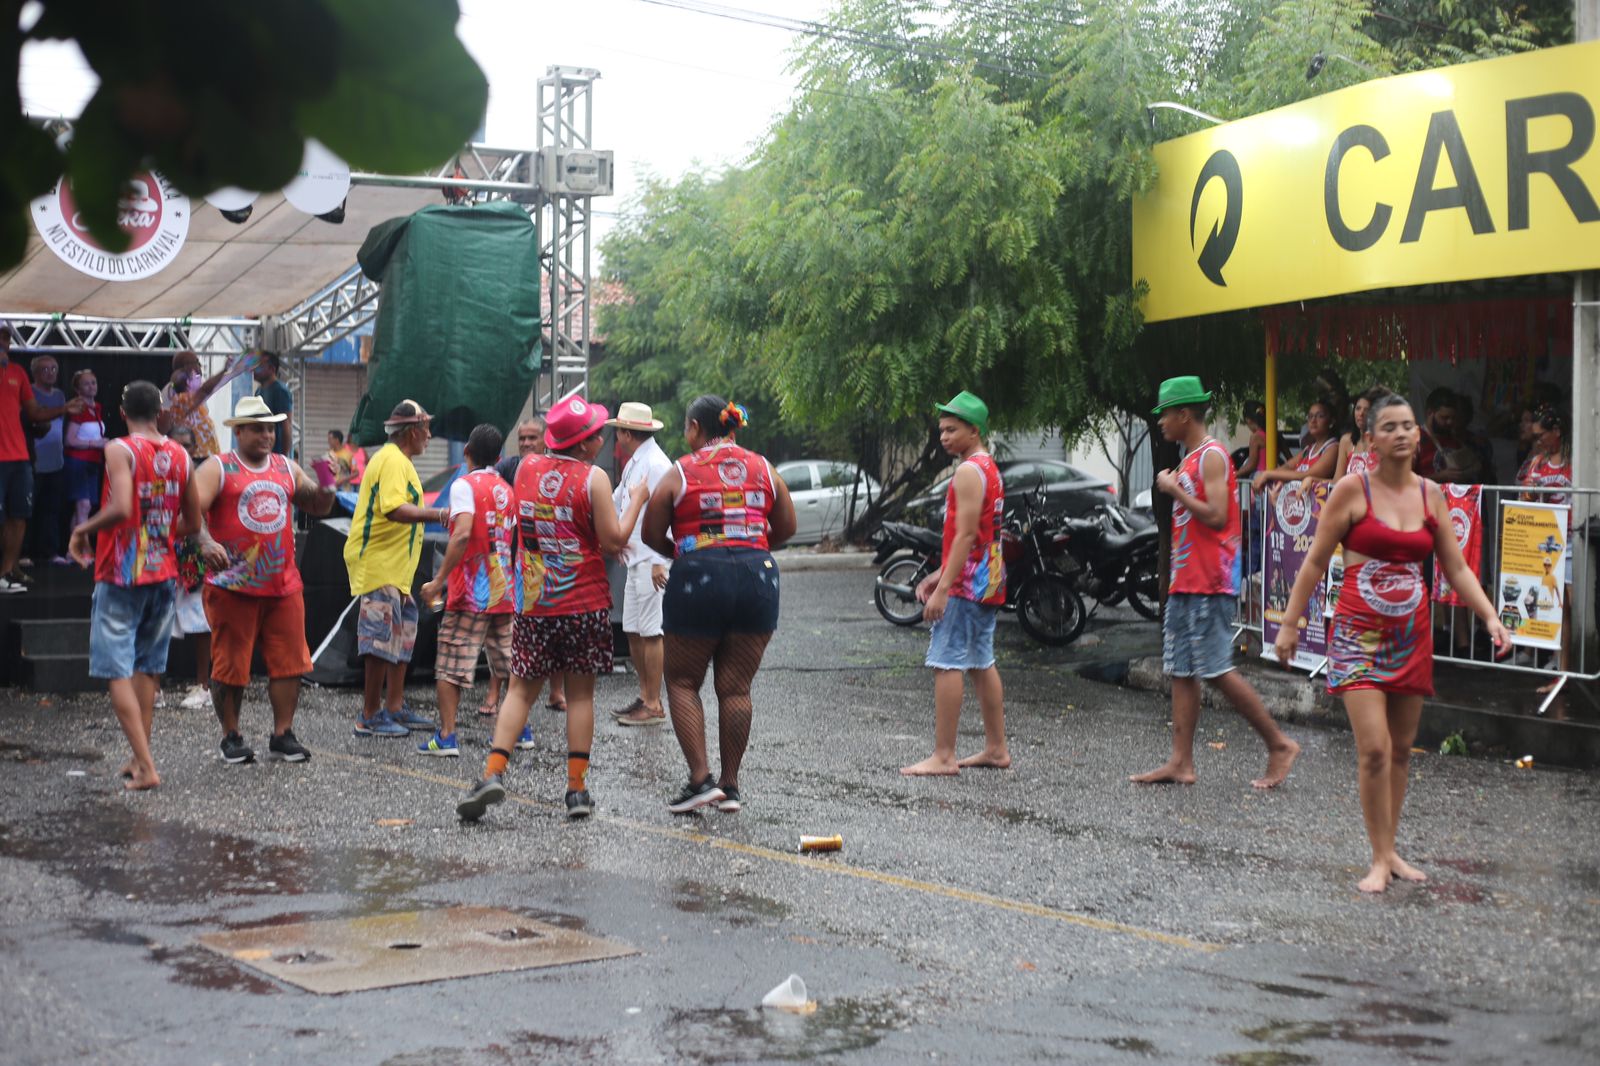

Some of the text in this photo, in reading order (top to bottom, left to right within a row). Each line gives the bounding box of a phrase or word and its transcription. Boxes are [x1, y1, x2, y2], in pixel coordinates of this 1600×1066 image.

[1324, 91, 1600, 252] CAR
[46, 223, 180, 275] NO ESTILO DO CARNAVAL
